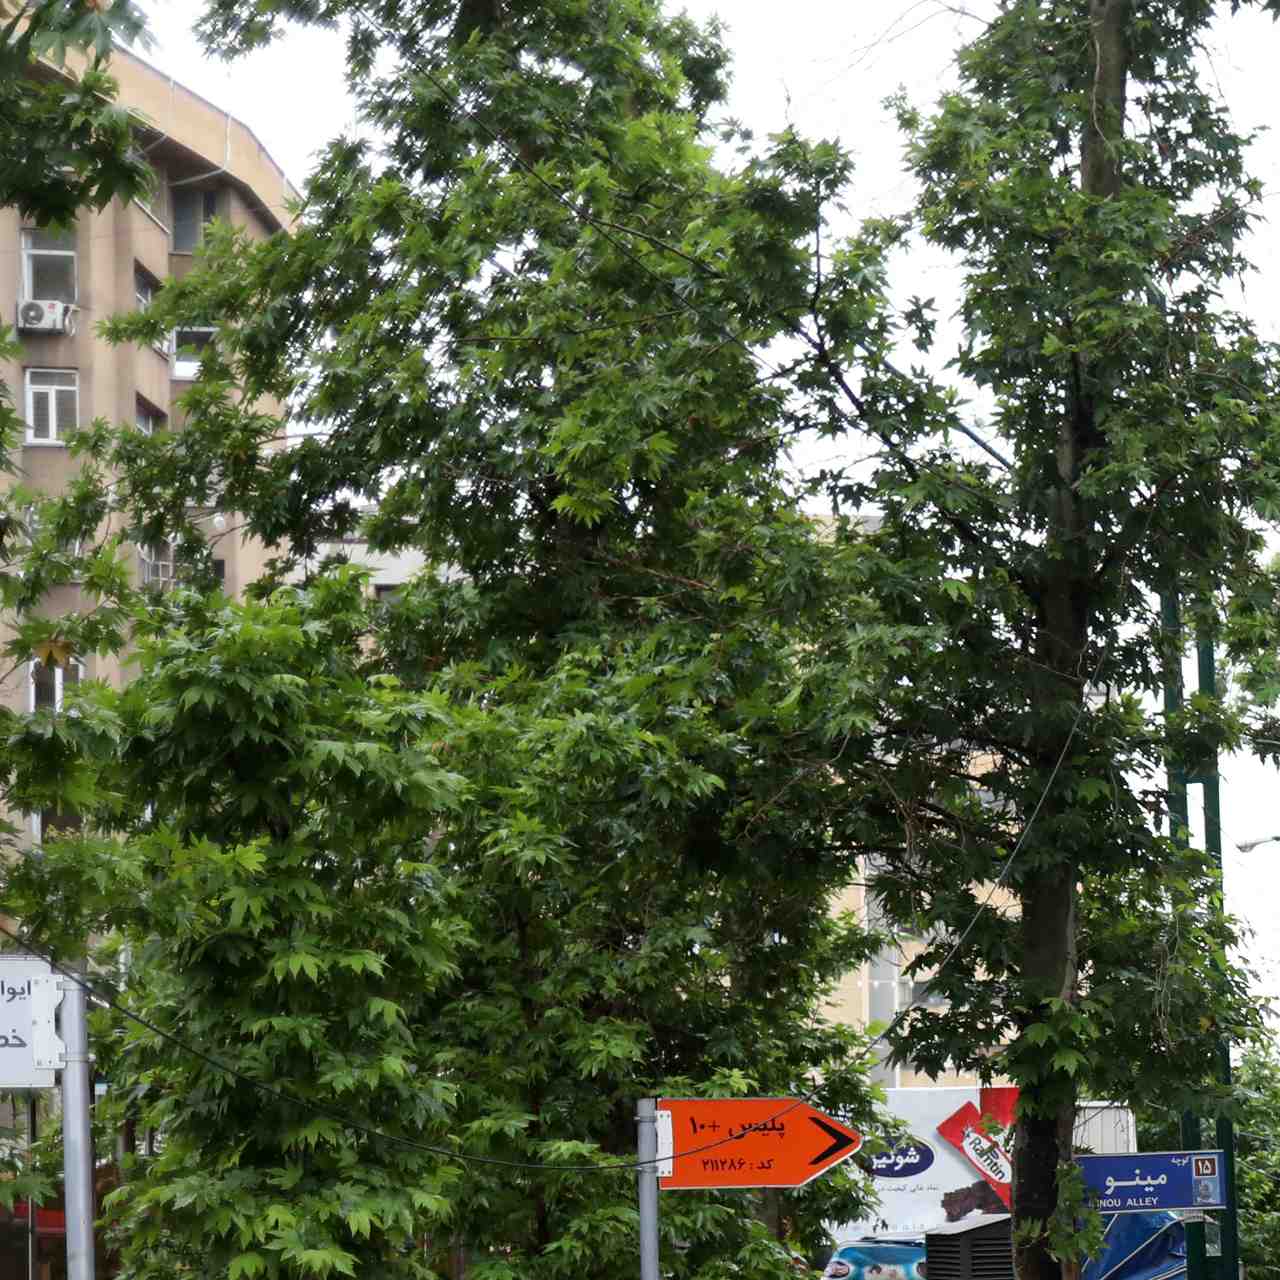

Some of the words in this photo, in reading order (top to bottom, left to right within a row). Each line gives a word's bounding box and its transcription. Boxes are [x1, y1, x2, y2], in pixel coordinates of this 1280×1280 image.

[727, 1117, 786, 1141] پلیس
[1197, 1159, 1213, 1174] ۱۵
[1104, 1168, 1168, 1196] مینو
[1126, 1196, 1159, 1207] ALLEY
